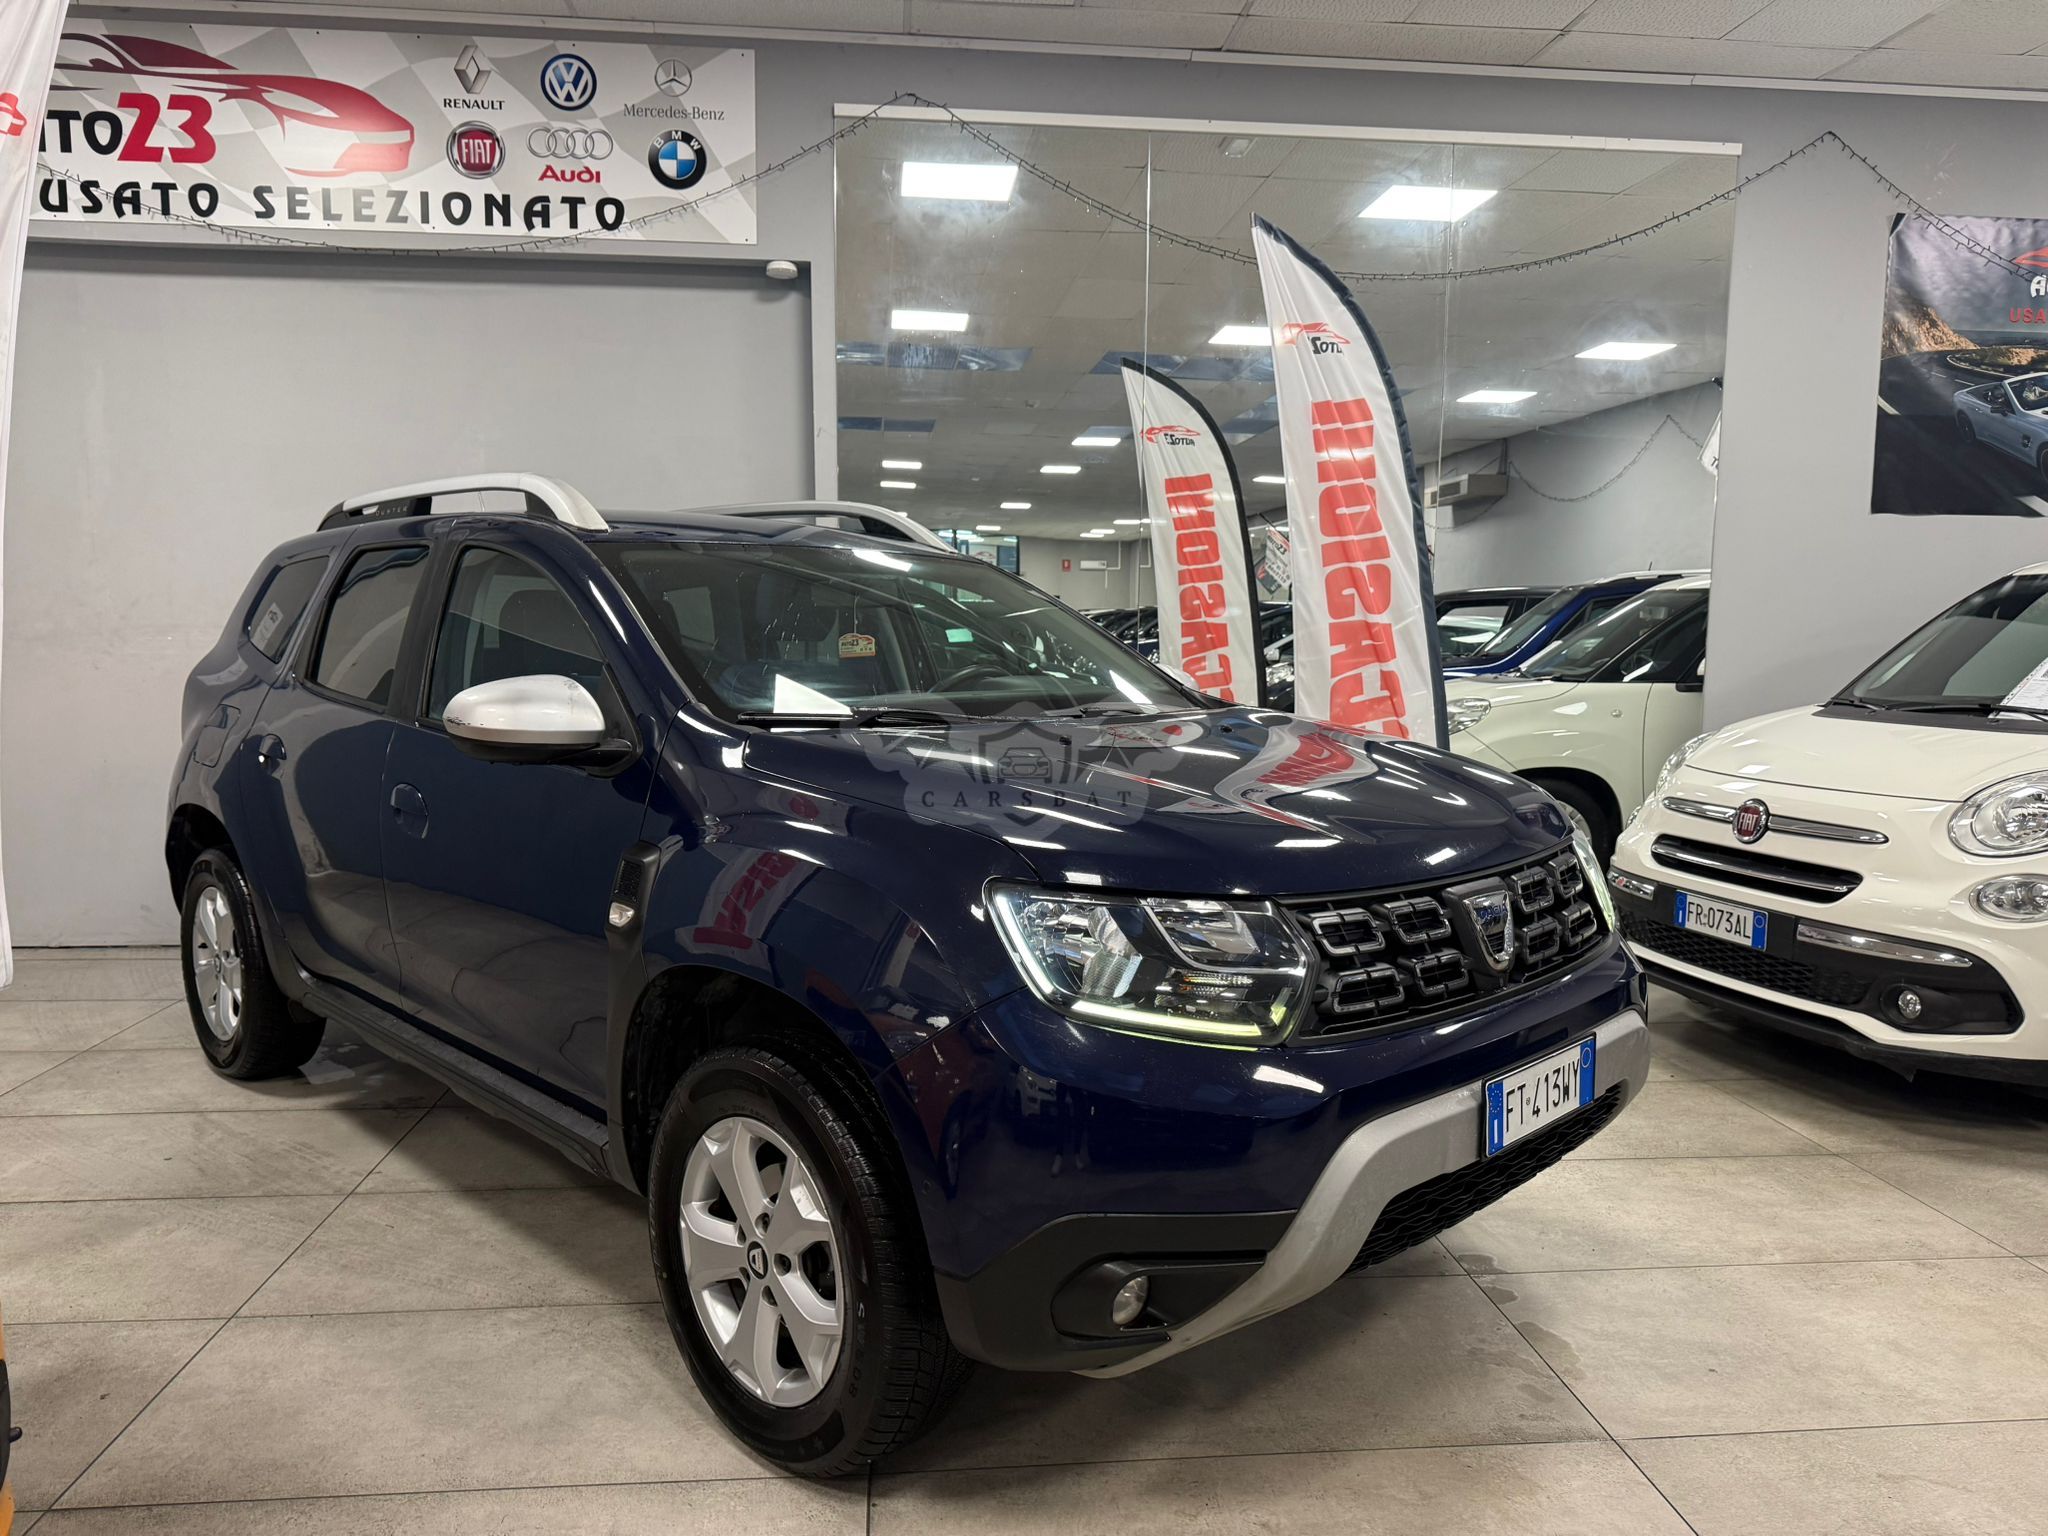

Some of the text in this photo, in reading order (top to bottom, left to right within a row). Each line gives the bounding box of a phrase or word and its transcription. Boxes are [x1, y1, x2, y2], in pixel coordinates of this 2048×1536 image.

[443, 98, 505, 111] RENAULT
[623, 103, 725, 121] Mercedes-Benz
[653, 129, 702, 151] BMW
[460, 138, 493, 165] FIAT
[538, 165, 601, 183] Audi
[39, 178, 625, 232] USATO SELEZIONATO
[1738, 812, 1759, 832] FIAT
